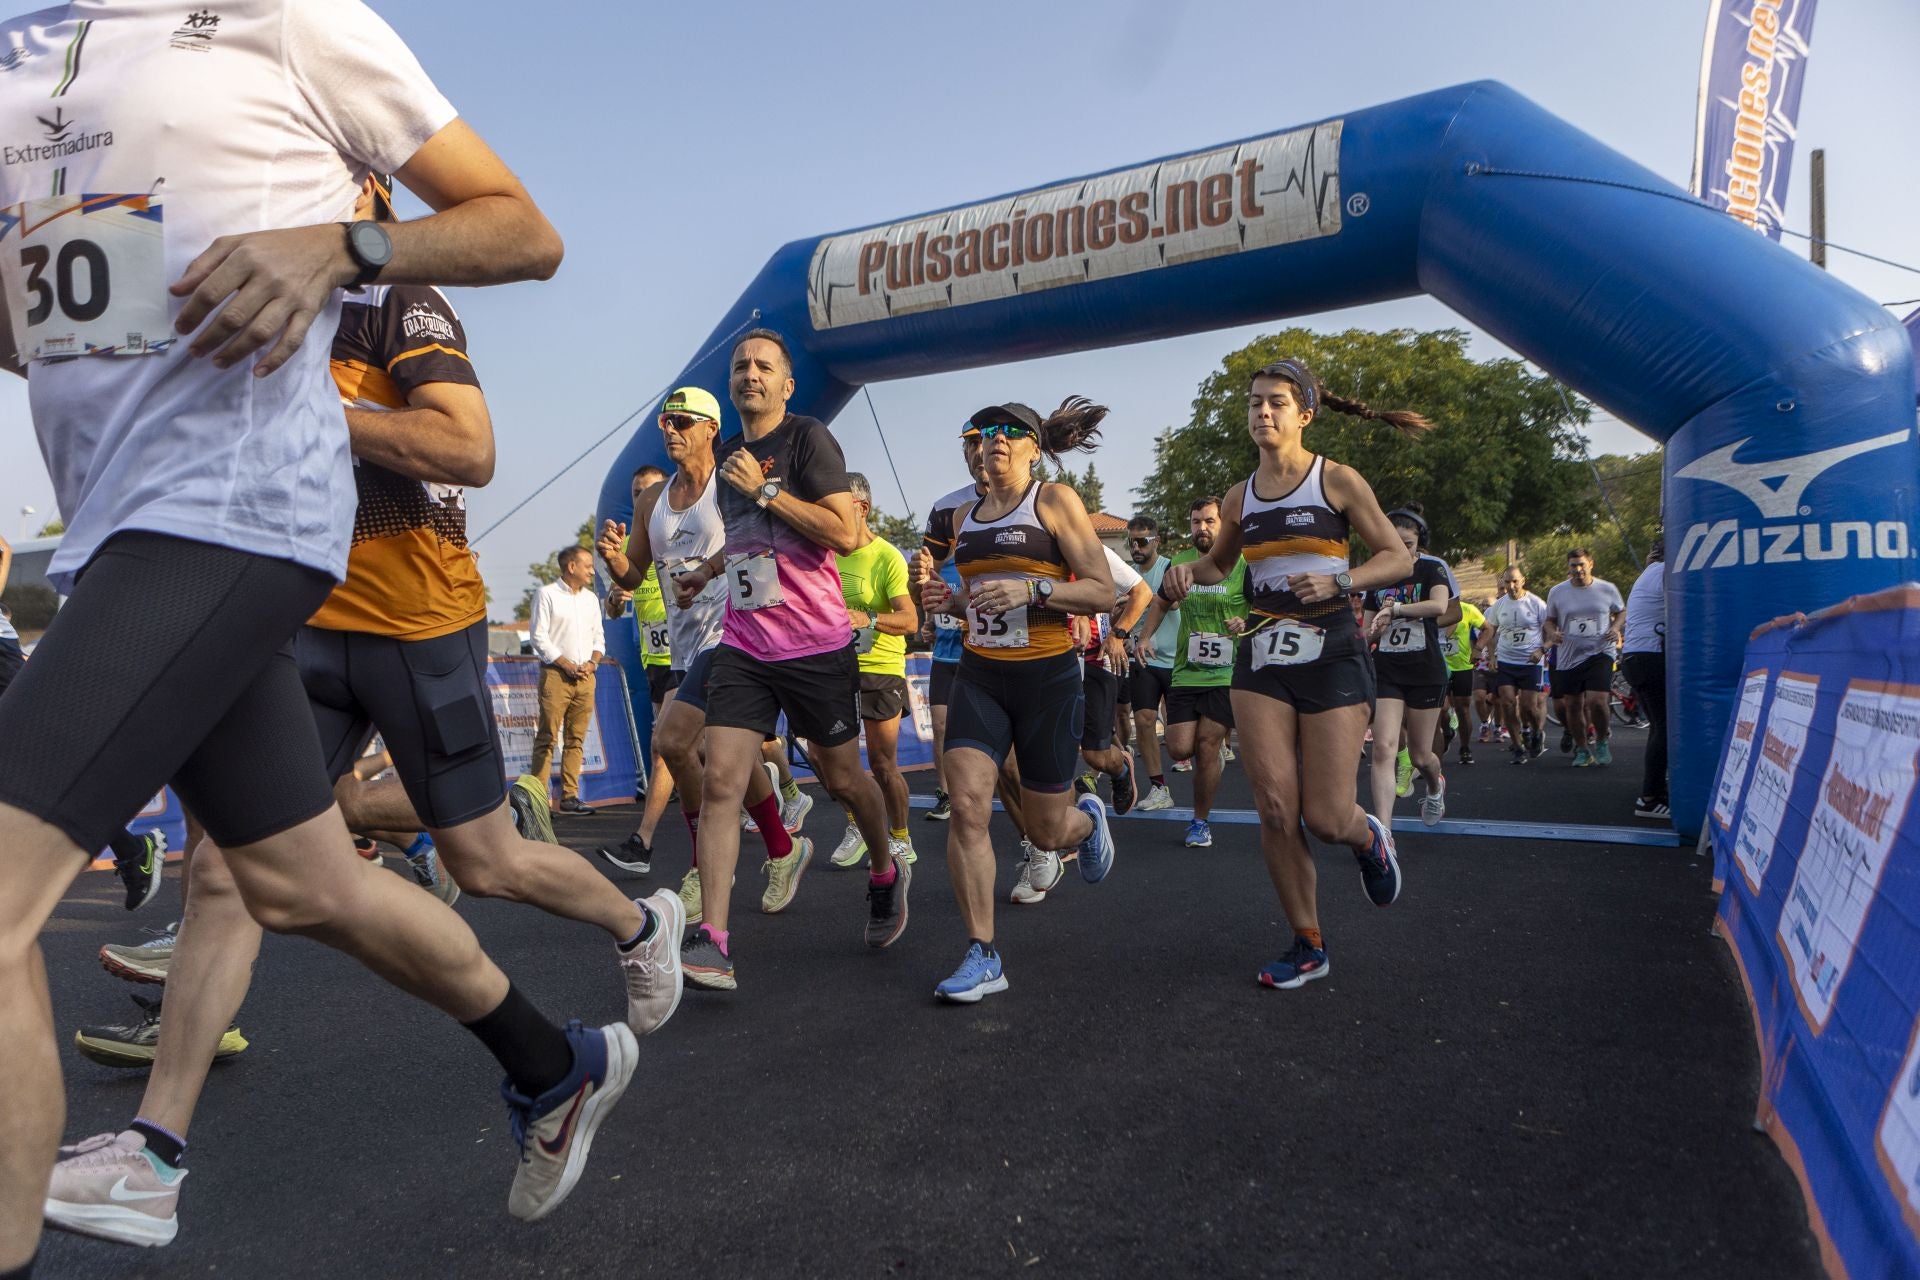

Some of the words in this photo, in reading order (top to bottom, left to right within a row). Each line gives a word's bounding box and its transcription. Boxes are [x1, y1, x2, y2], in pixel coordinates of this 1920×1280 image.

[4, 130, 114, 166] Extremadura
[858, 158, 1264, 296] Pulsaciones.net
[20, 238, 111, 328] 30
[1672, 518, 1909, 574] MIZUNO
[737, 569, 753, 598] 5
[976, 609, 1009, 636] 53
[1198, 640, 1222, 659] 55
[1268, 631, 1301, 656] 15
[1389, 628, 1411, 646] 67
[1512, 632, 1526, 642] 57
